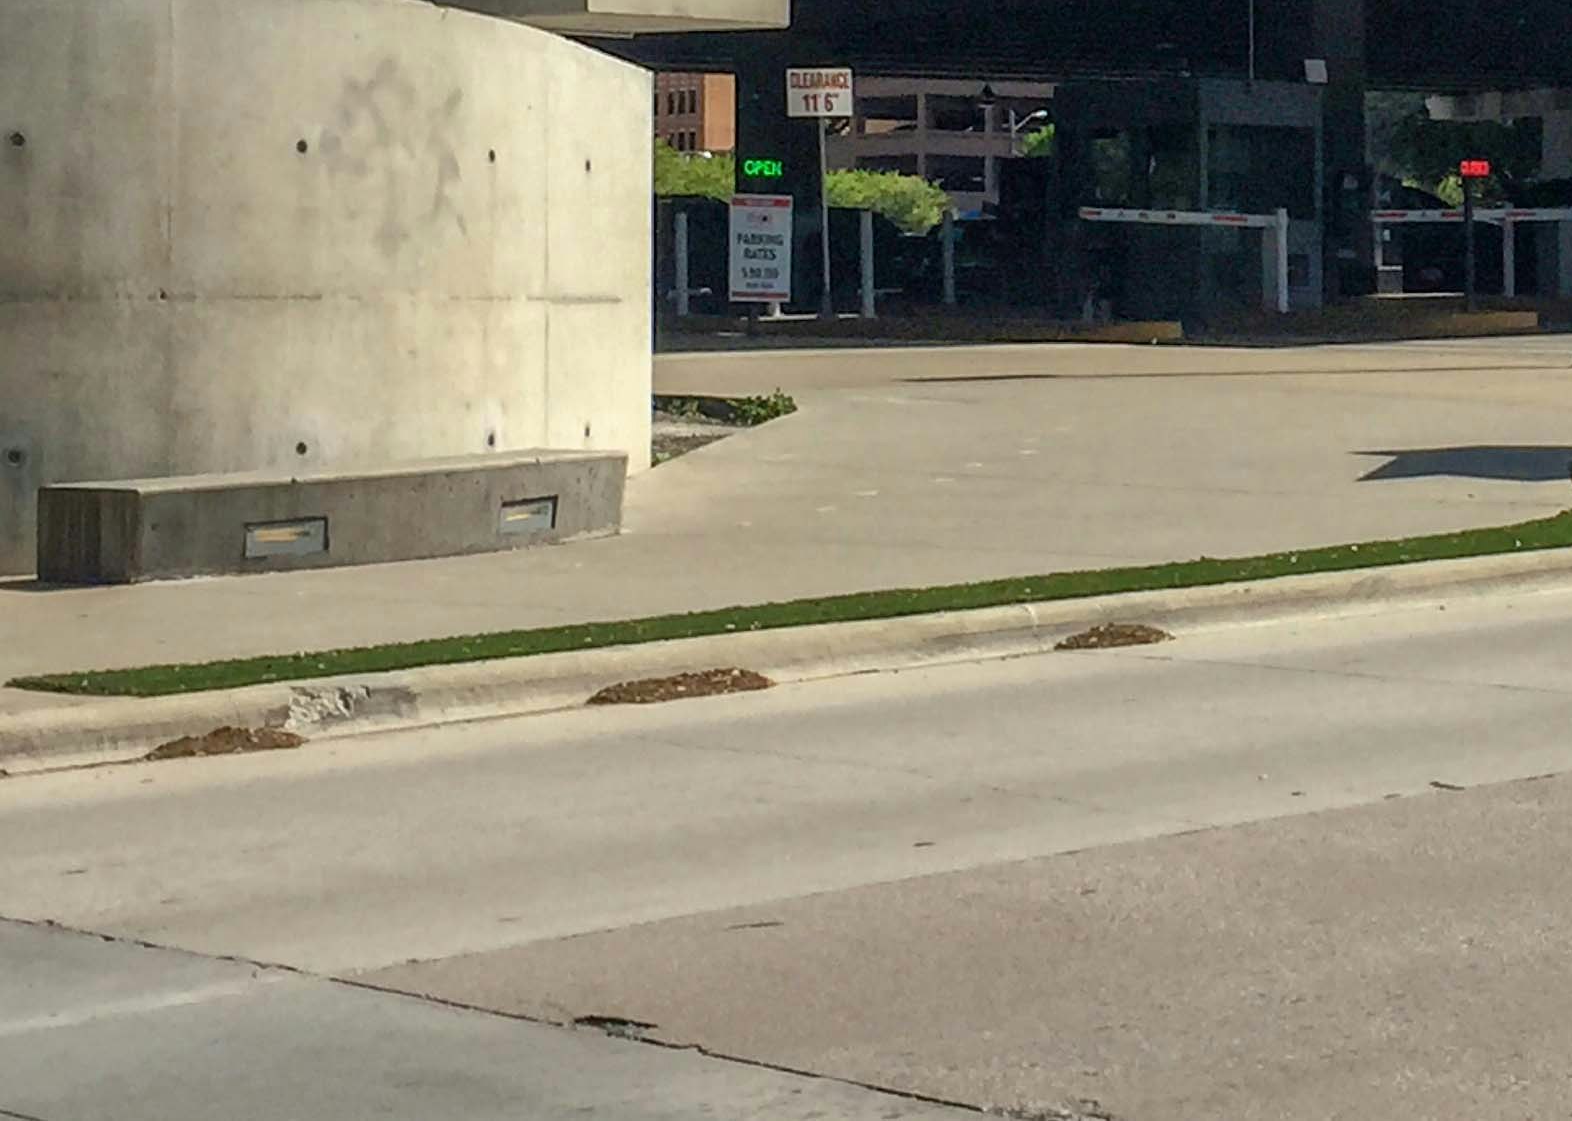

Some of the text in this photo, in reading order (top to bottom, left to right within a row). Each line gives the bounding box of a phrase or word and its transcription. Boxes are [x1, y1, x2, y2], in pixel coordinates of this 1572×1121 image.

[790, 72, 849, 89] CLEARANCE
[744, 160, 782, 176] OPEN
[737, 233, 783, 246] PARKING
[744, 247, 776, 260] RATES
